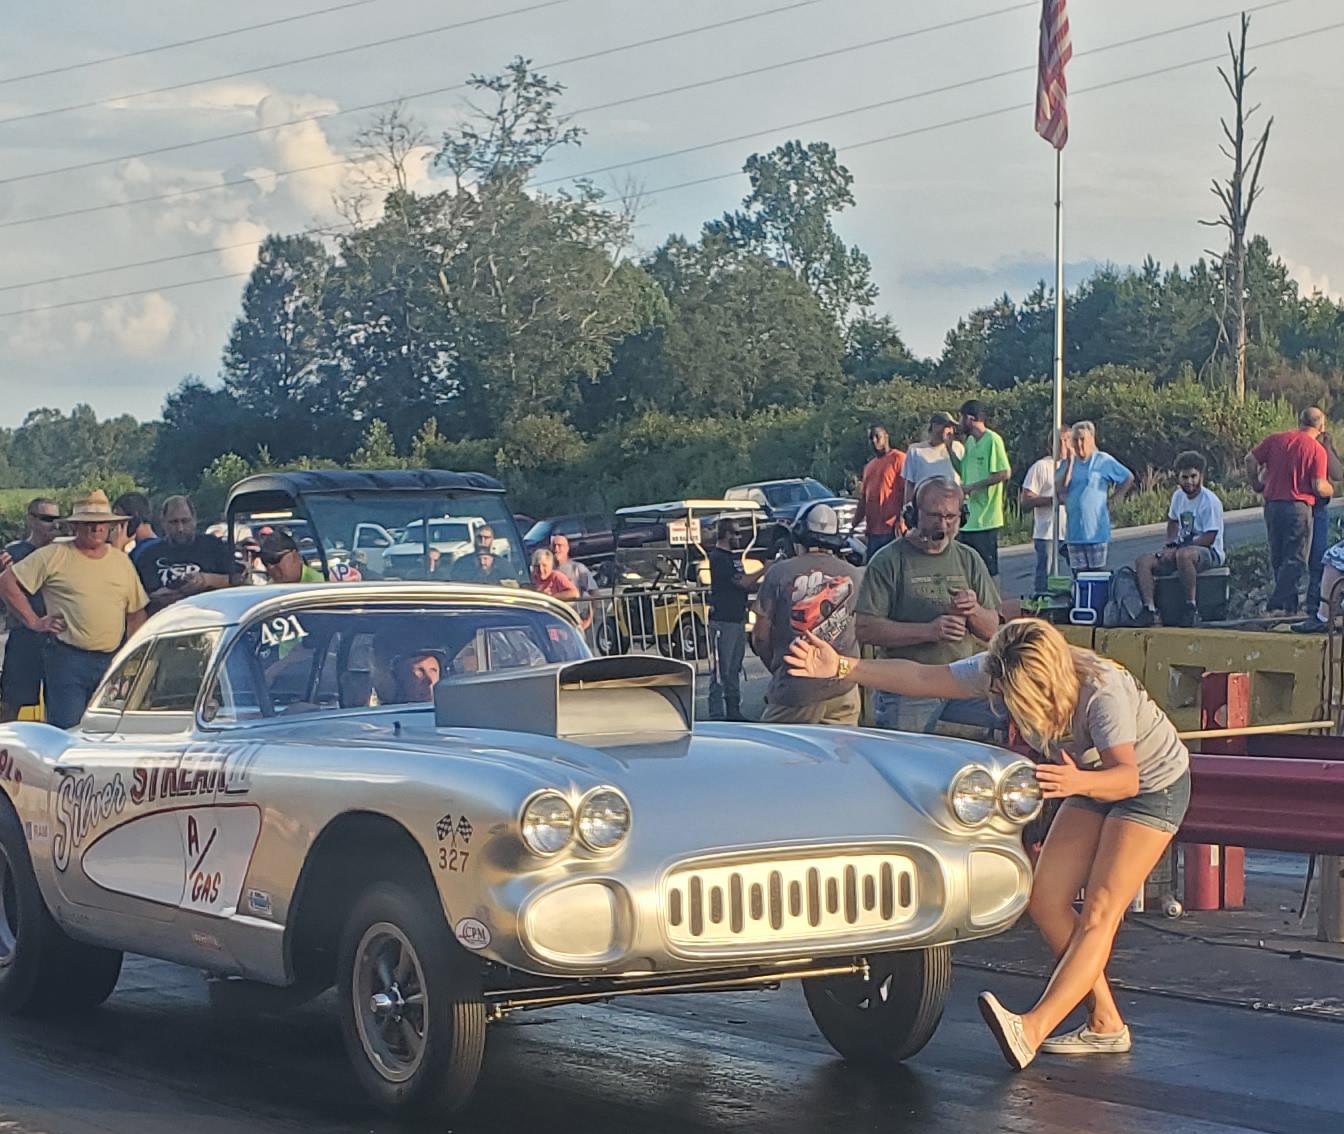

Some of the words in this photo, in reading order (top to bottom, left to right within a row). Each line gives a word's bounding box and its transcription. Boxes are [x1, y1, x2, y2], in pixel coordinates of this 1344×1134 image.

[260, 614, 308, 647] 421
[53, 772, 127, 873] Silver
[438, 847, 470, 873] 327
[191, 871, 222, 904] GAS
